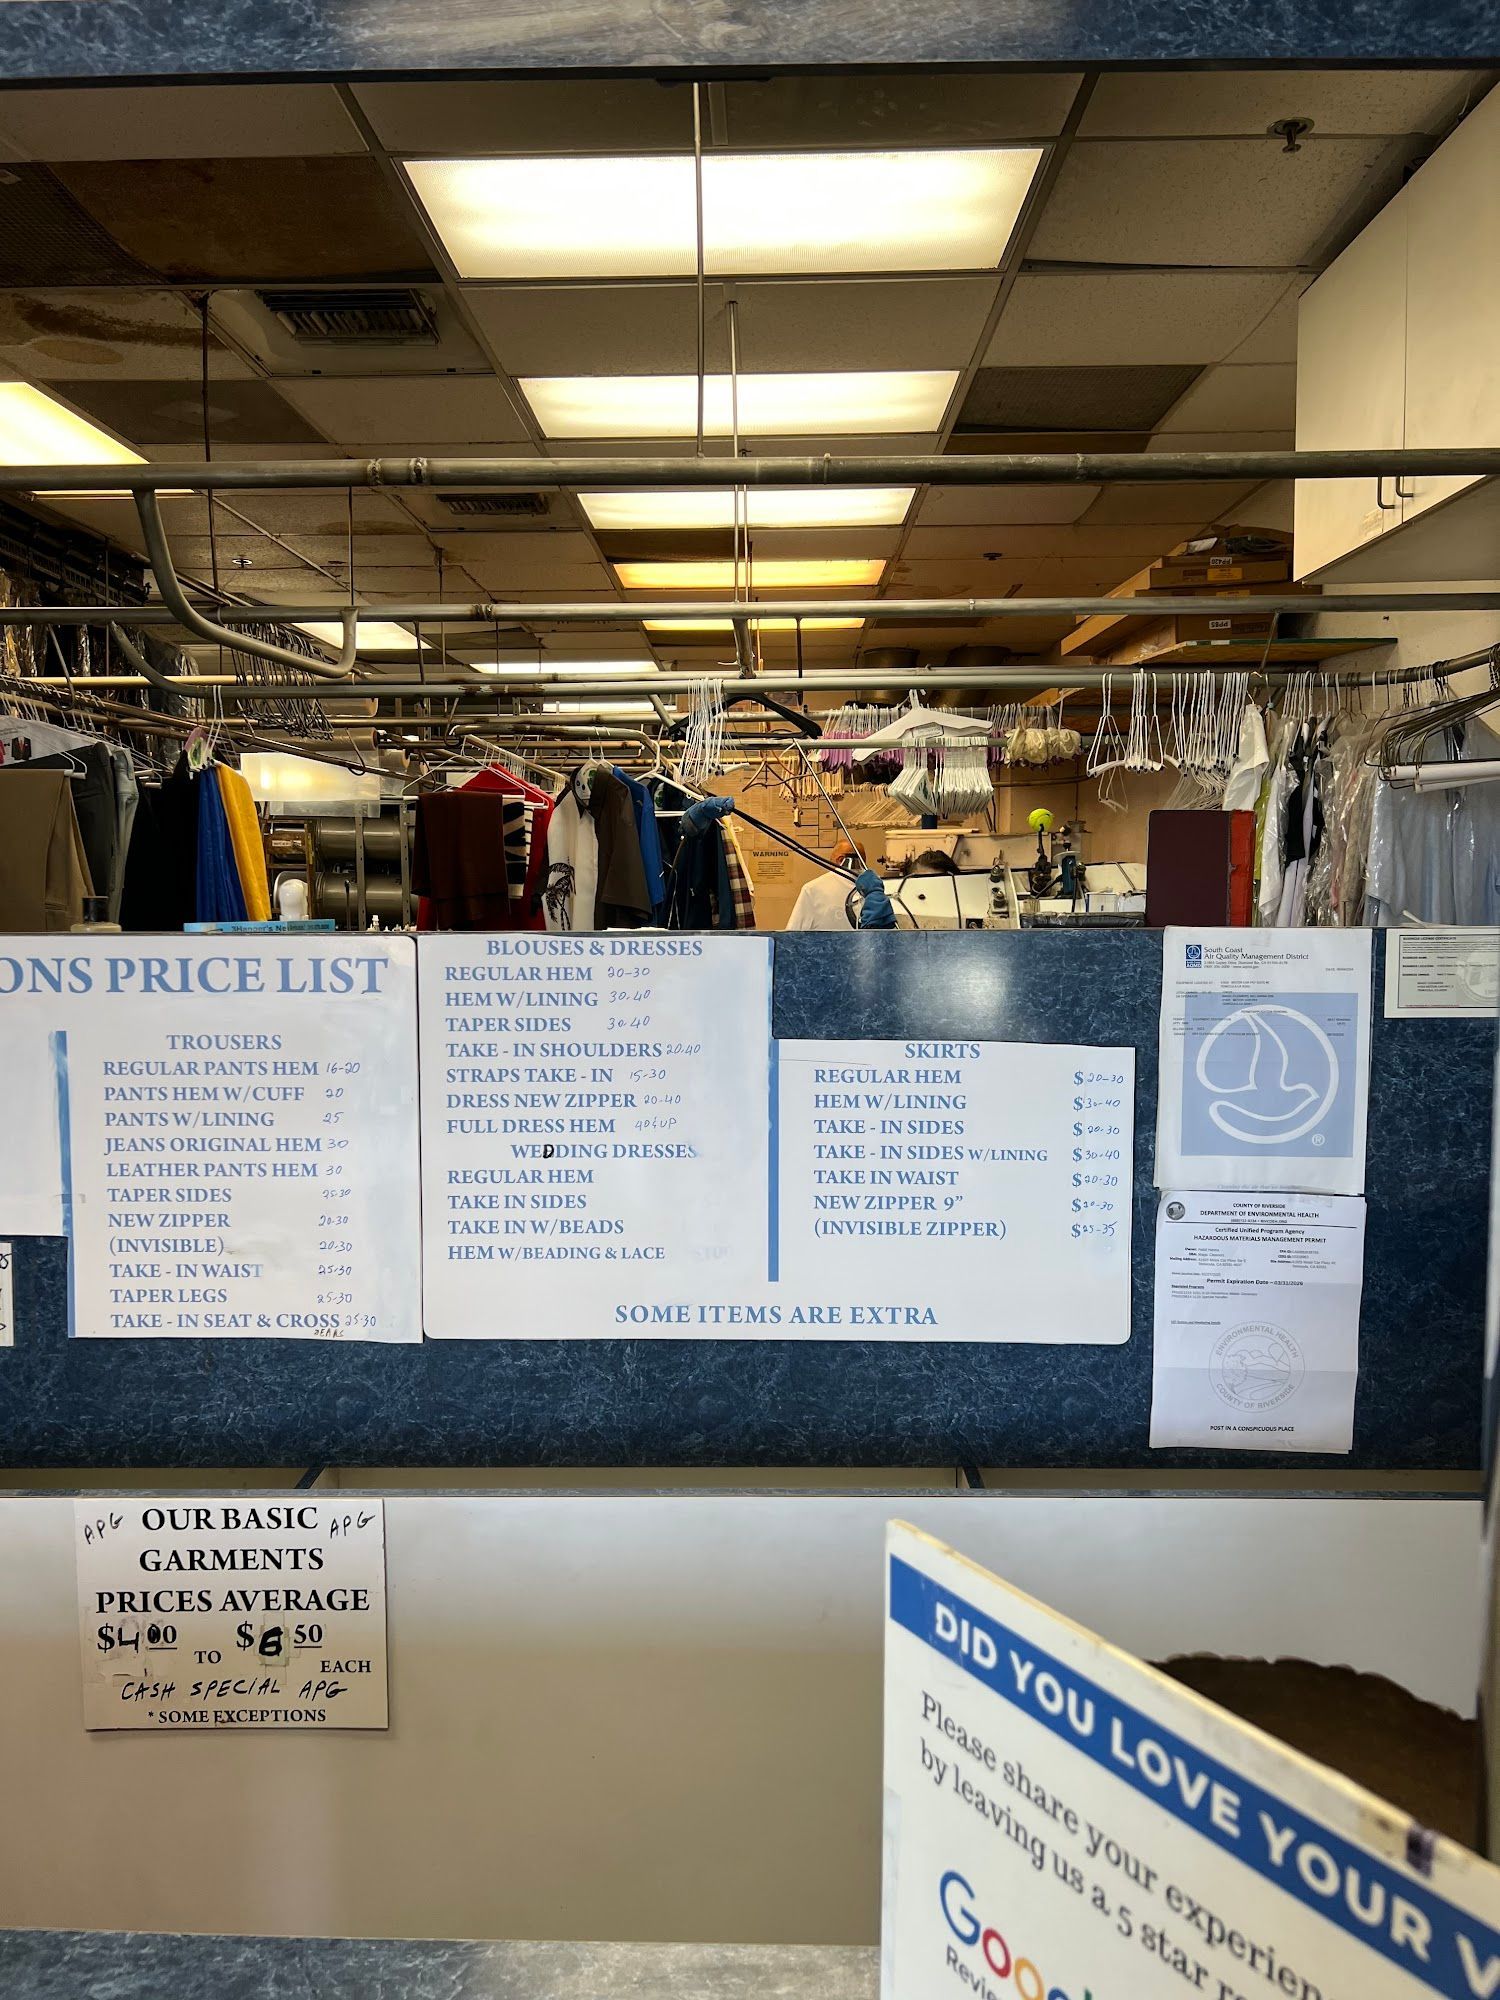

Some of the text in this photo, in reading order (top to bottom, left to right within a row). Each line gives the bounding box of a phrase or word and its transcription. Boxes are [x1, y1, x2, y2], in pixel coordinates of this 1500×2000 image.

[487, 940, 702, 956] BLOUSES & DRESSES
[1216, 953, 1239, 961] Quality
[0, 956, 388, 994] ONS PRICE LIST
[445, 967, 543, 981] REGULAR
[546, 967, 592, 980] HEM
[445, 991, 598, 1008] HEM W/LINING
[166, 1035, 281, 1050] TROUSERS
[446, 1043, 662, 1057] TAKE IN SHOULDERS
[905, 1043, 980, 1059] SKIRTS
[103, 1061, 201, 1075] REGULAR
[204, 1061, 268, 1075] PANTS
[272, 1062, 319, 1075] HEM
[447, 1069, 520, 1083] STRAPS
[525, 1069, 576, 1082] TAKE
[591, 1069, 613, 1082] IN
[814, 1069, 962, 1084] REGULAR HEM
[104, 1086, 343, 1102] PANTS HEM W/CUFF 20
[447, 1094, 509, 1108] DRESS
[514, 1094, 561, 1108] NEW
[565, 1094, 637, 1107] ZIPPER
[447, 1119, 615, 1133] FULL DRESS HEM
[104, 1138, 349, 1155] JEANS ORIGINAL HEM 30
[511, 1143, 697, 1159] WEDDING DRESSES
[814, 1145, 1048, 1162] TAKE IN SIDES W/LINING
[107, 1163, 342, 1177] LEATHER PANTS HEM 30
[814, 1170, 959, 1185] TAKE IN WAIST
[107, 1188, 232, 1202] TAPER SIDES
[814, 1196, 861, 1210] NEW
[864, 1196, 937, 1210] ZIPPER
[108, 1214, 231, 1227] NEW ZIPPER
[448, 1219, 623, 1236] TAKE IN W/BEADS
[814, 1219, 1006, 1239] (INVISIBLE ZIPPER)
[109, 1236, 225, 1255] (INVISIBLE)
[448, 1246, 665, 1261] HEM W/BEADING & LACE
[109, 1264, 263, 1279] TAKE IN WAIST
[111, 1313, 340, 1329] TAKE IN SEAT & CROSS
[615, 1304, 938, 1325] SOME ITEMS ARE EXTRA
[1215, 1325, 1299, 1358] ENVIRONMENTAL HEALTH
[1216, 1383, 1243, 1406] COUNTY
[1258, 1383, 1295, 1409] RIVERSIDE
[142, 1508, 217, 1530] OUR
[221, 1507, 318, 1530] BASIC
[330, 1511, 376, 1539] APG
[139, 1548, 324, 1572] GARMENTS
[96, 1589, 370, 1613] PRICES AVERAGE
[194, 1651, 221, 1664] TO
[320, 1660, 371, 1673] EACH
[121, 1677, 348, 1700] CASH SPECIAL APG
[158, 1709, 326, 1724] SOME EXCEPTIONS
[934, 1601, 997, 1670] DID
[1009, 1650, 1095, 1737] YOU
[1110, 1717, 1242, 1839] LOVE
[1258, 1812, 1432, 1961] YOUR
[921, 1691, 997, 1771] Please
[1003, 1756, 1079, 1836] share
[1084, 1822, 1159, 1891] your
[920, 1739, 1209, 1987] by leaving us a 5 star
